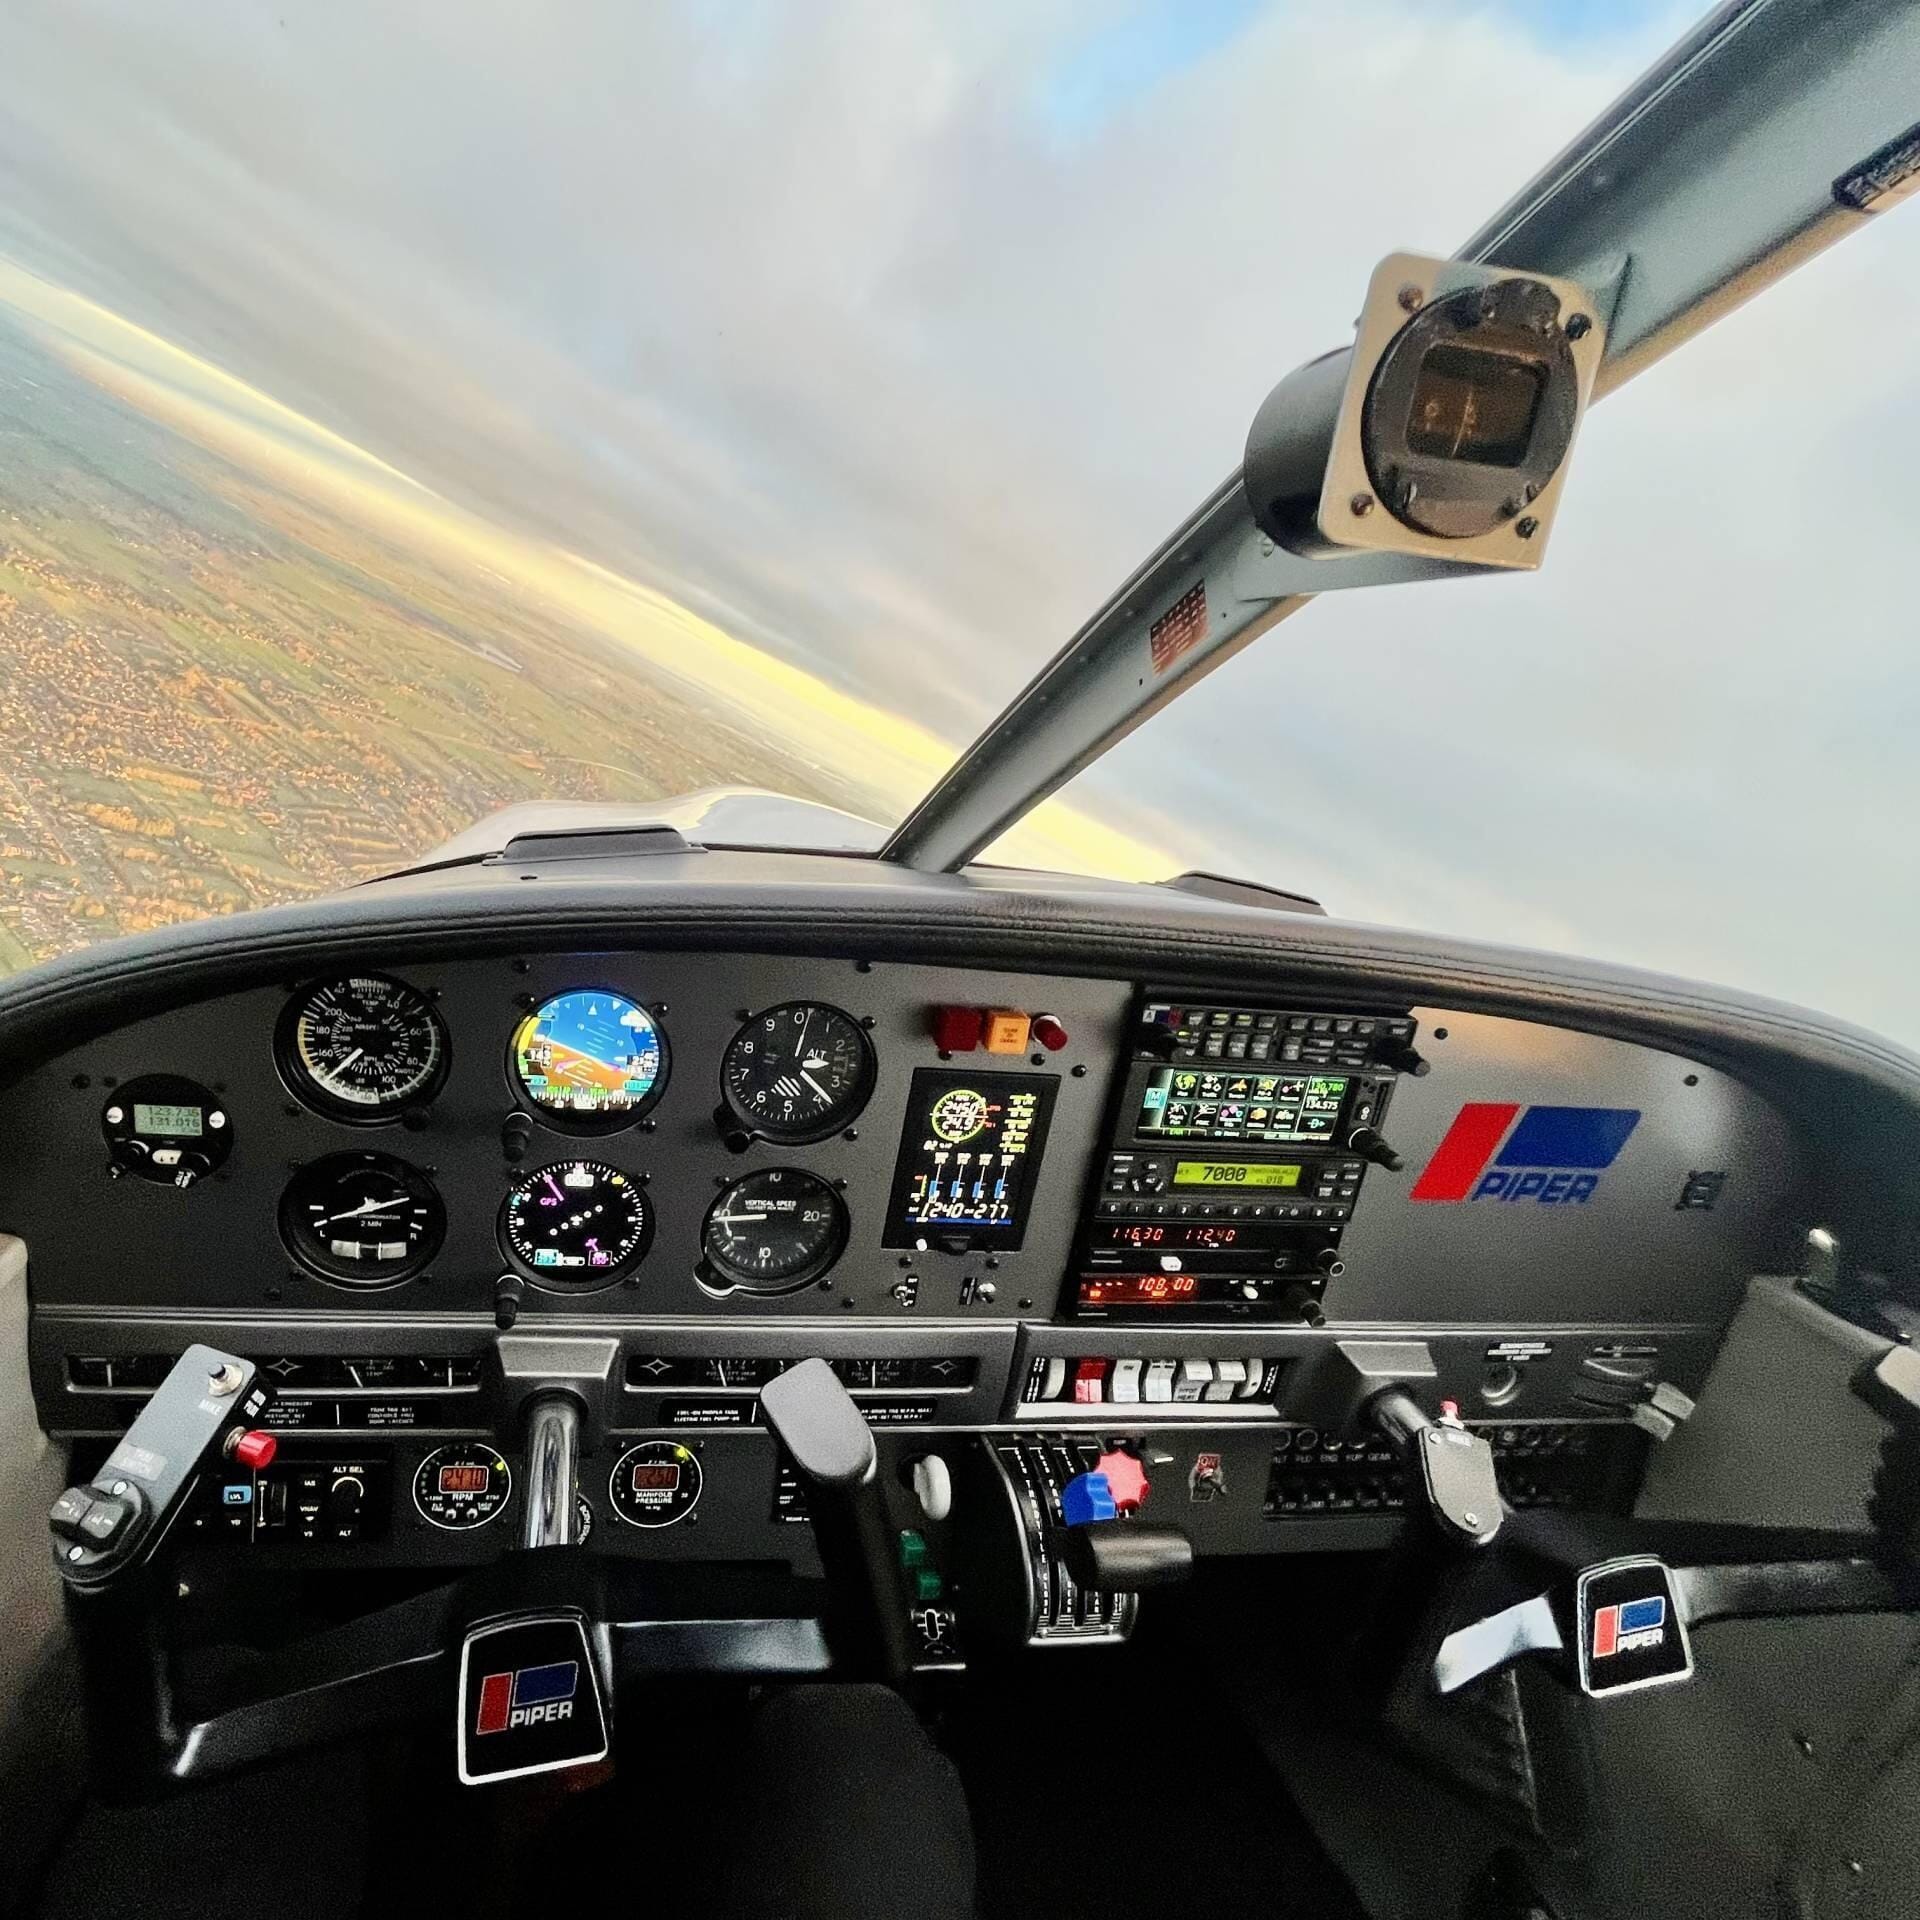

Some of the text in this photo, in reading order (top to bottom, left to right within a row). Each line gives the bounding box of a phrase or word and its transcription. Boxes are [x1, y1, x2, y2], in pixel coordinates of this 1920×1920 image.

[387, 1001, 400, 1009] 40
[325, 1008, 342, 1016] 200
[794, 1011, 805, 1024] 0
[316, 1026, 330, 1034] 180
[765, 1019, 775, 1031] 9
[410, 1028, 422, 1036] 60
[744, 1041, 753, 1053] 8
[835, 1039, 845, 1052] 2
[318, 1049, 334, 1057] 160
[806, 1048, 827, 1060] ALT
[407, 1057, 418, 1065] 80
[382, 1075, 397, 1084] 100
[740, 1068, 750, 1080] 7
[831, 1075, 841, 1088] 3
[756, 1090, 766, 1103] 6
[783, 1100, 793, 1112] 5
[942, 1100, 979, 1115] 2450
[942, 1115, 975, 1130] 24.9
[1202, 1166, 1247, 1181] 7000
[1471, 1172, 1598, 1203] PIPER
[540, 1197, 557, 1206] GPS
[803, 1210, 820, 1222] 20
[973, 1204, 1008, 1219] 277
[320, 1230, 326, 1238] L
[759, 1247, 771, 1259] 10
[1139, 1278, 1194, 1291] 108.00
[1617, 1628, 1663, 1653] PIPER
[510, 1701, 573, 1728] PIPER
